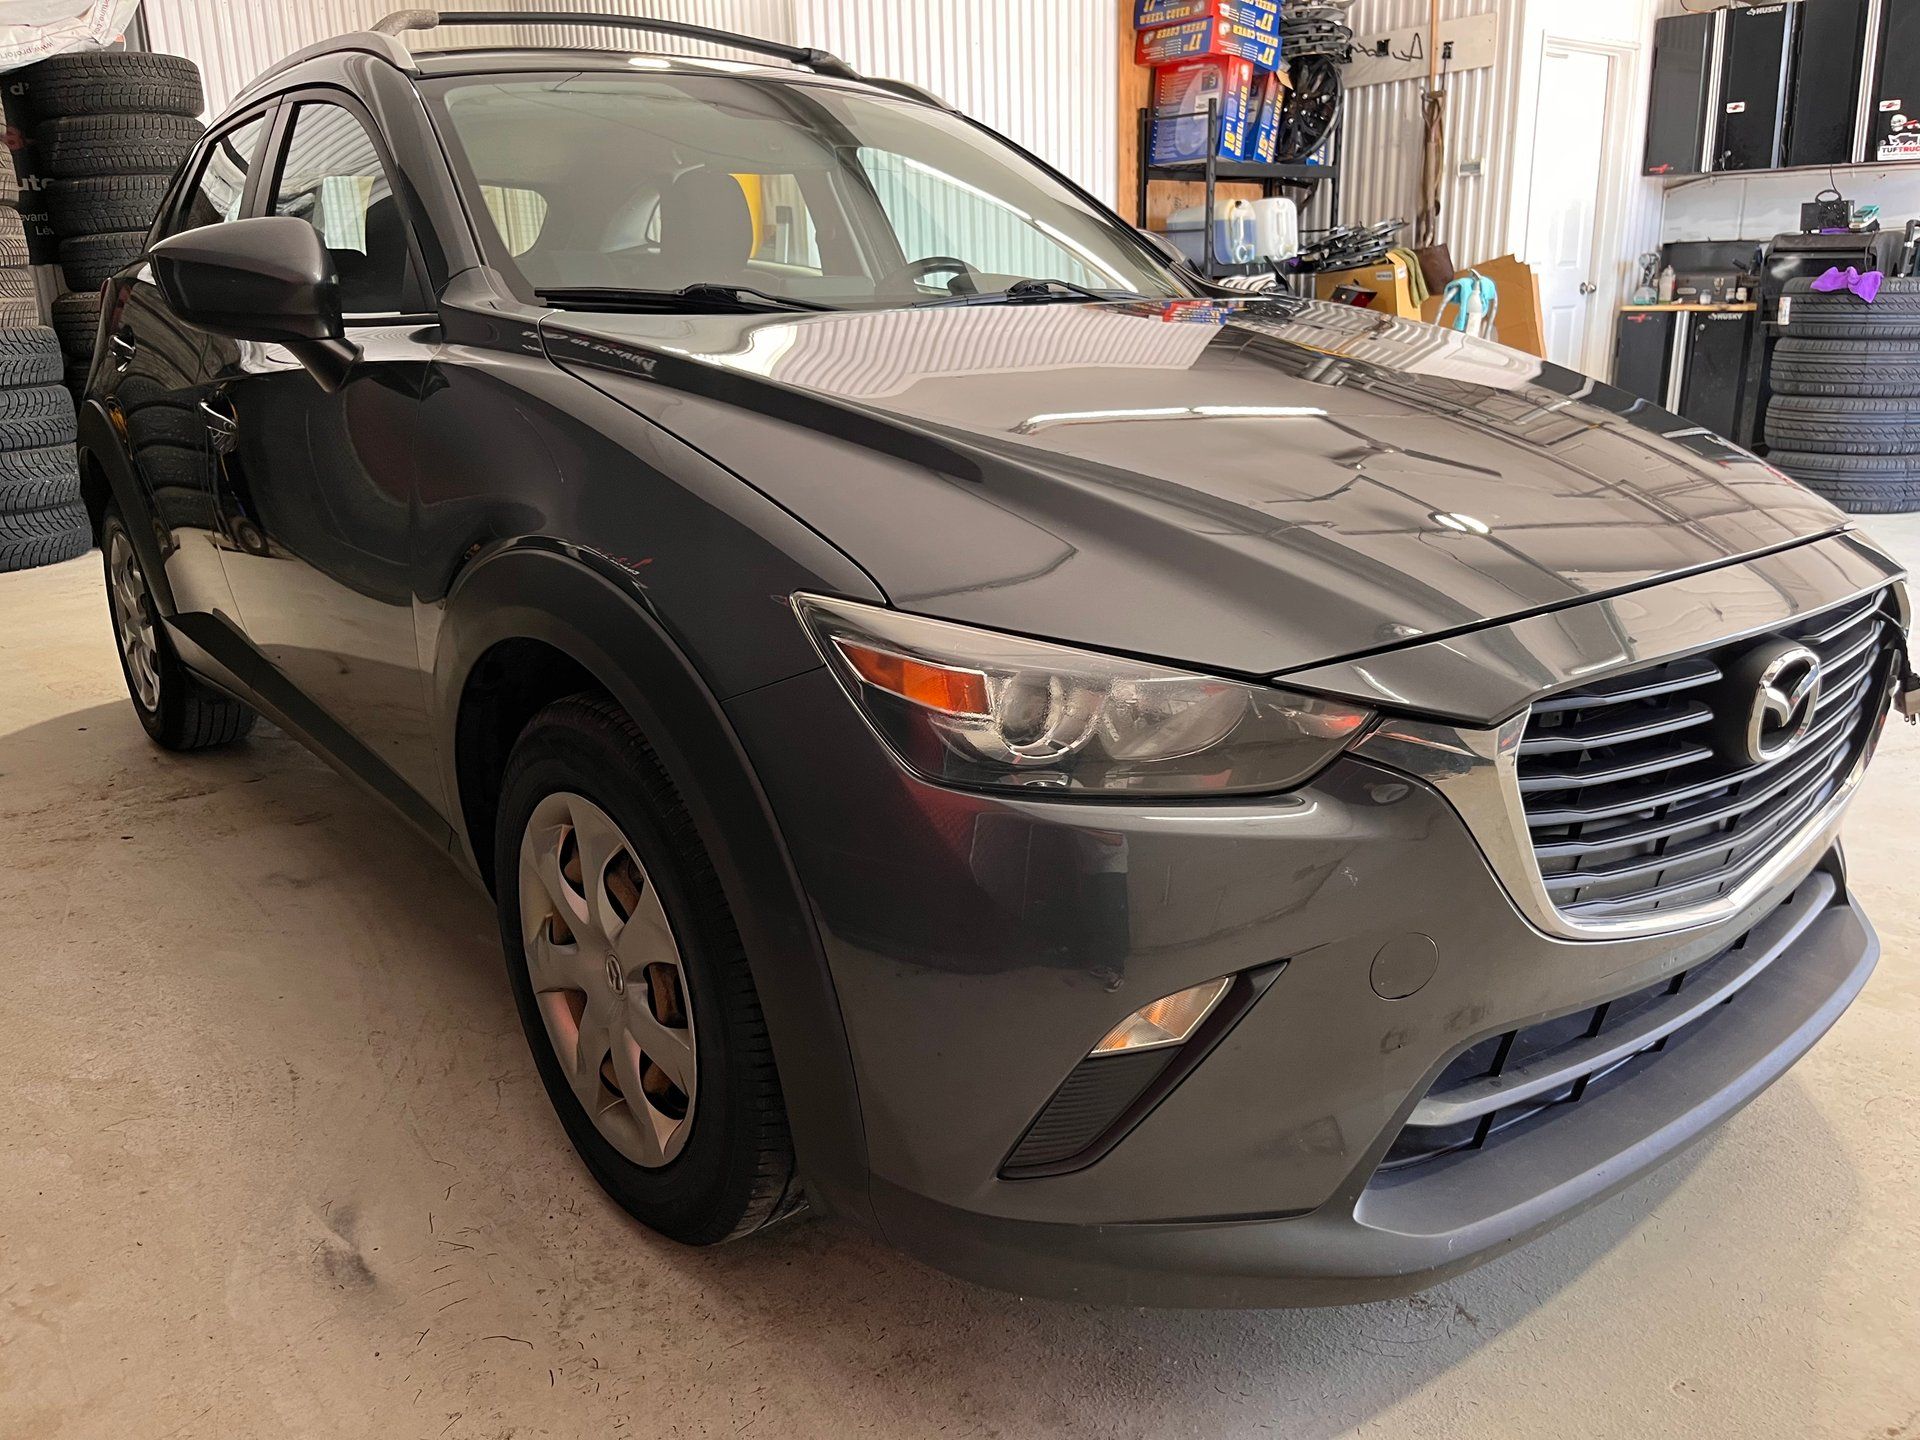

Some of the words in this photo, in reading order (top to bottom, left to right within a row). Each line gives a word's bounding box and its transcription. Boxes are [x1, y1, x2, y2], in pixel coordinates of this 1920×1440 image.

[1140, 11, 1165, 25] WHEEL
[1166, 6, 1191, 20] COVER
[1756, 5, 1783, 15] HUSKY
[1156, 26, 1180, 39] COVER
[1182, 21, 1207, 34] WHEEL
[1233, 24, 1255, 39] COVER
[1257, 32, 1279, 48] WHEEL
[1239, 86, 1248, 120] COVER
[1234, 121, 1245, 157] WHEEL
[1266, 128, 1277, 164] WHEEL
[1717, 312, 1743, 320] HUSKY
